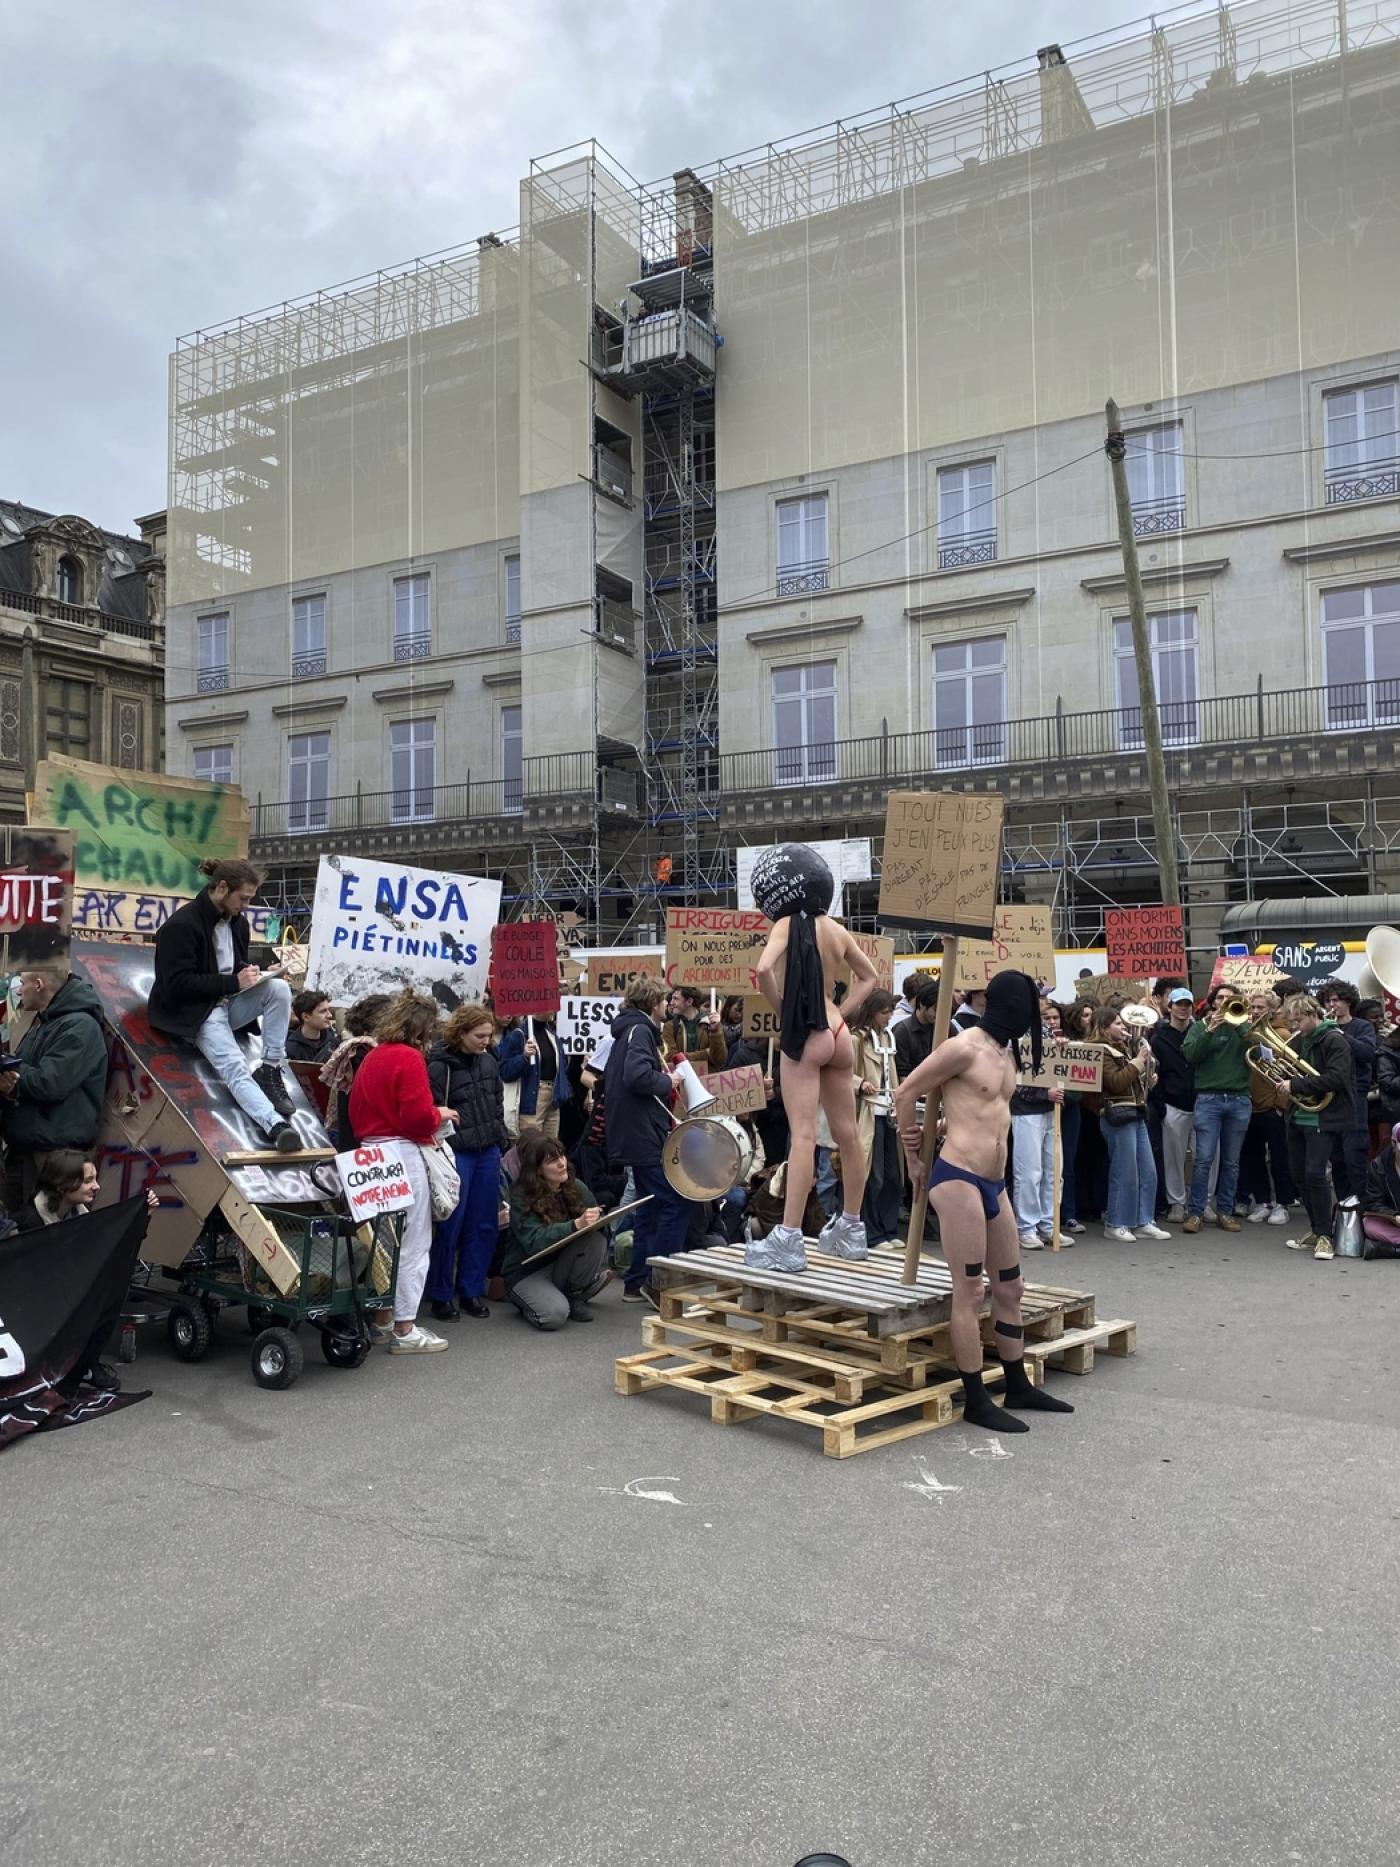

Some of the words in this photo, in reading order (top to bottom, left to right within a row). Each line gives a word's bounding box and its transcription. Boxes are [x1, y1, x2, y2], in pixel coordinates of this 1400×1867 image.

[56, 780, 222, 844] ARCHI
[896, 800, 946, 822] TOUT
[955, 801, 992, 823] NUES
[892, 827, 931, 849] J'EN
[936, 829, 967, 851] PEUX
[971, 831, 996, 852] PLUS
[339, 874, 469, 922] ENSA
[668, 909, 768, 931] IRRIGUEZ
[1107, 911, 1132, 926] ON
[1134, 910, 1177, 924] FORME
[1106, 926, 1138, 941] SANS
[1140, 925, 1184, 940] MOYENS
[504, 944, 545, 962] COULE
[681, 940, 697, 952] ON
[703, 941, 726, 952] NOUS
[1107, 943, 1126, 956] LES
[694, 956, 714, 965] POUR
[719, 955, 733, 963] DES
[1274, 946, 1312, 968] SANS
[1315, 945, 1341, 953] ARGENT
[1314, 953, 1340, 963] PUBLIC
[517, 967, 556, 979] MAISONS
[1107, 960, 1125, 974] DE
[1131, 958, 1182, 973] DEMAIN
[567, 1001, 616, 1025] LESS
[575, 1022, 590, 1037] IS
[560, 1035, 604, 1053] MOR
[1019, 1044, 1056, 1058] NUS
[1060, 1046, 1102, 1061] LAISSEZ
[1021, 1061, 1045, 1076] PS
[1054, 1064, 1069, 1076] EN
[1071, 1064, 1097, 1080] PLAN
[706, 1067, 761, 1095] ENSA
